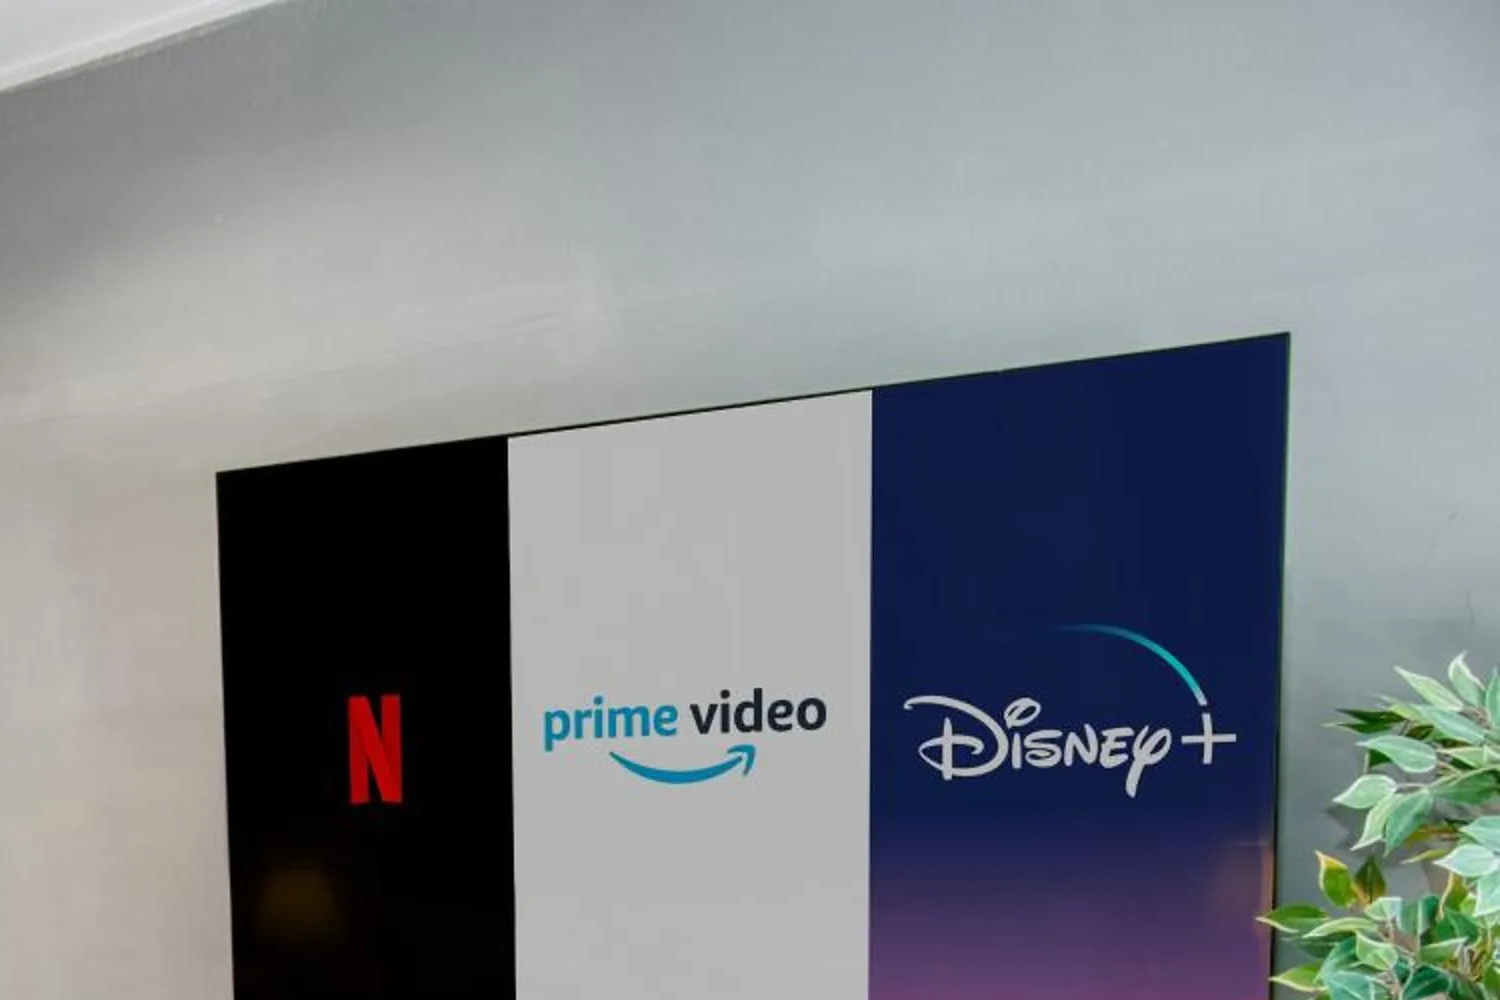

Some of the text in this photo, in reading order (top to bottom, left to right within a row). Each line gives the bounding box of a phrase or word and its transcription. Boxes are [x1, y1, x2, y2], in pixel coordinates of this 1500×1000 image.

[347, 694, 402, 804] N
[543, 687, 828, 752] prime video
